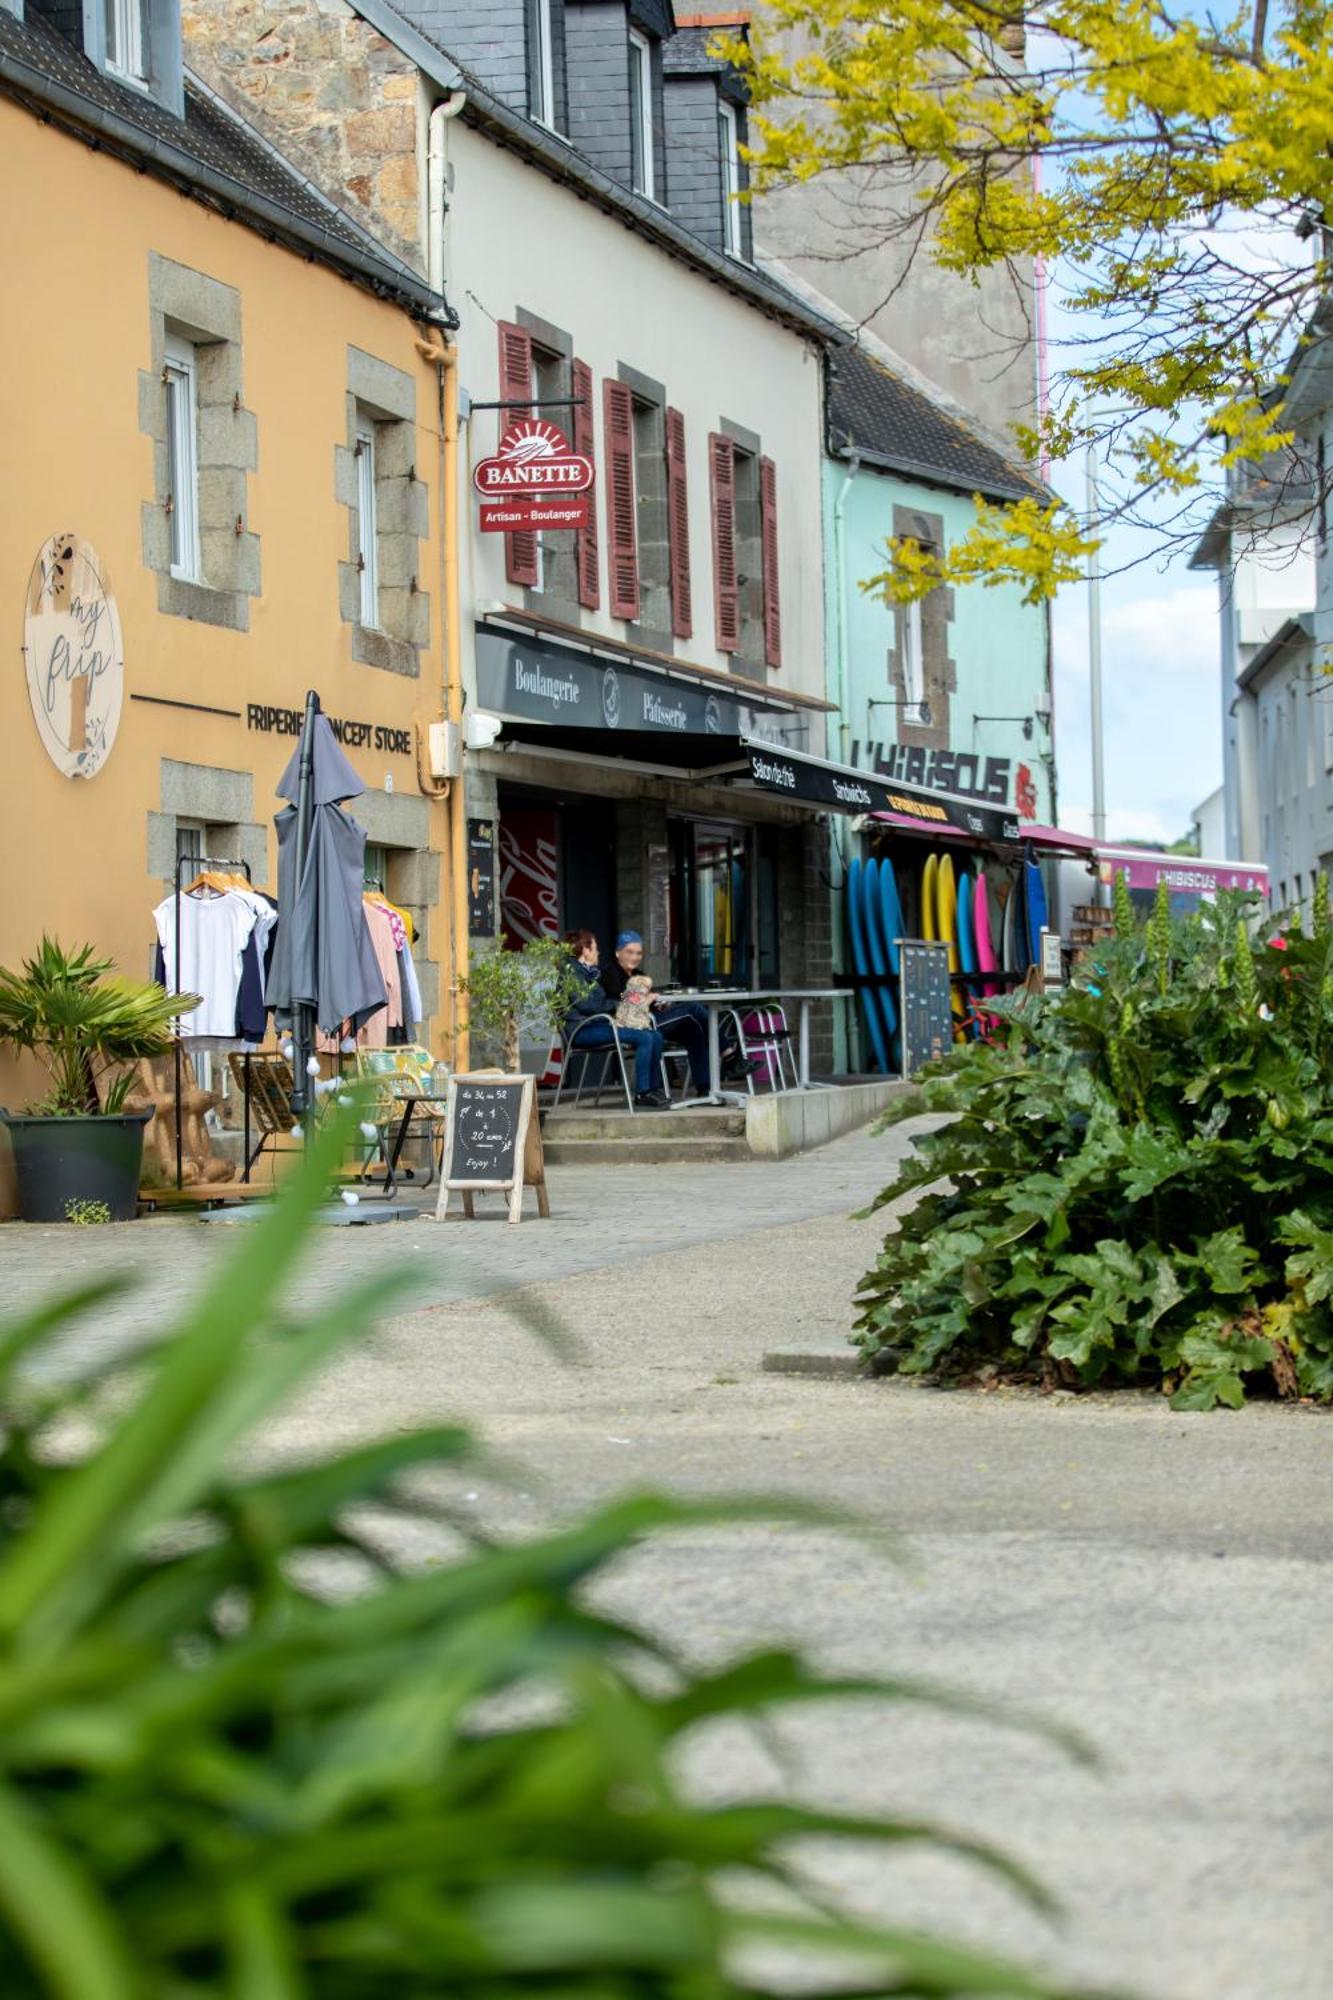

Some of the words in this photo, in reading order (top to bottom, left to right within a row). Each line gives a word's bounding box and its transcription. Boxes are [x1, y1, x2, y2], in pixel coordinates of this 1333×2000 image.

[486, 465, 582, 485] BANETTE
[485, 511, 521, 522] Artisan
[530, 509, 582, 521] Boulanger
[69, 595, 105, 648] my
[45, 634, 112, 712] frip
[515, 659, 580, 709] Boulangerie
[643, 692, 687, 730] Pâtisserie
[375, 725, 411, 755] STORE
[752, 757, 773, 782] Salon
[496, 1089, 508, 1099] 52
[471, 1131, 485, 1141] 20
[466, 1158, 489, 1169] Enjoy
